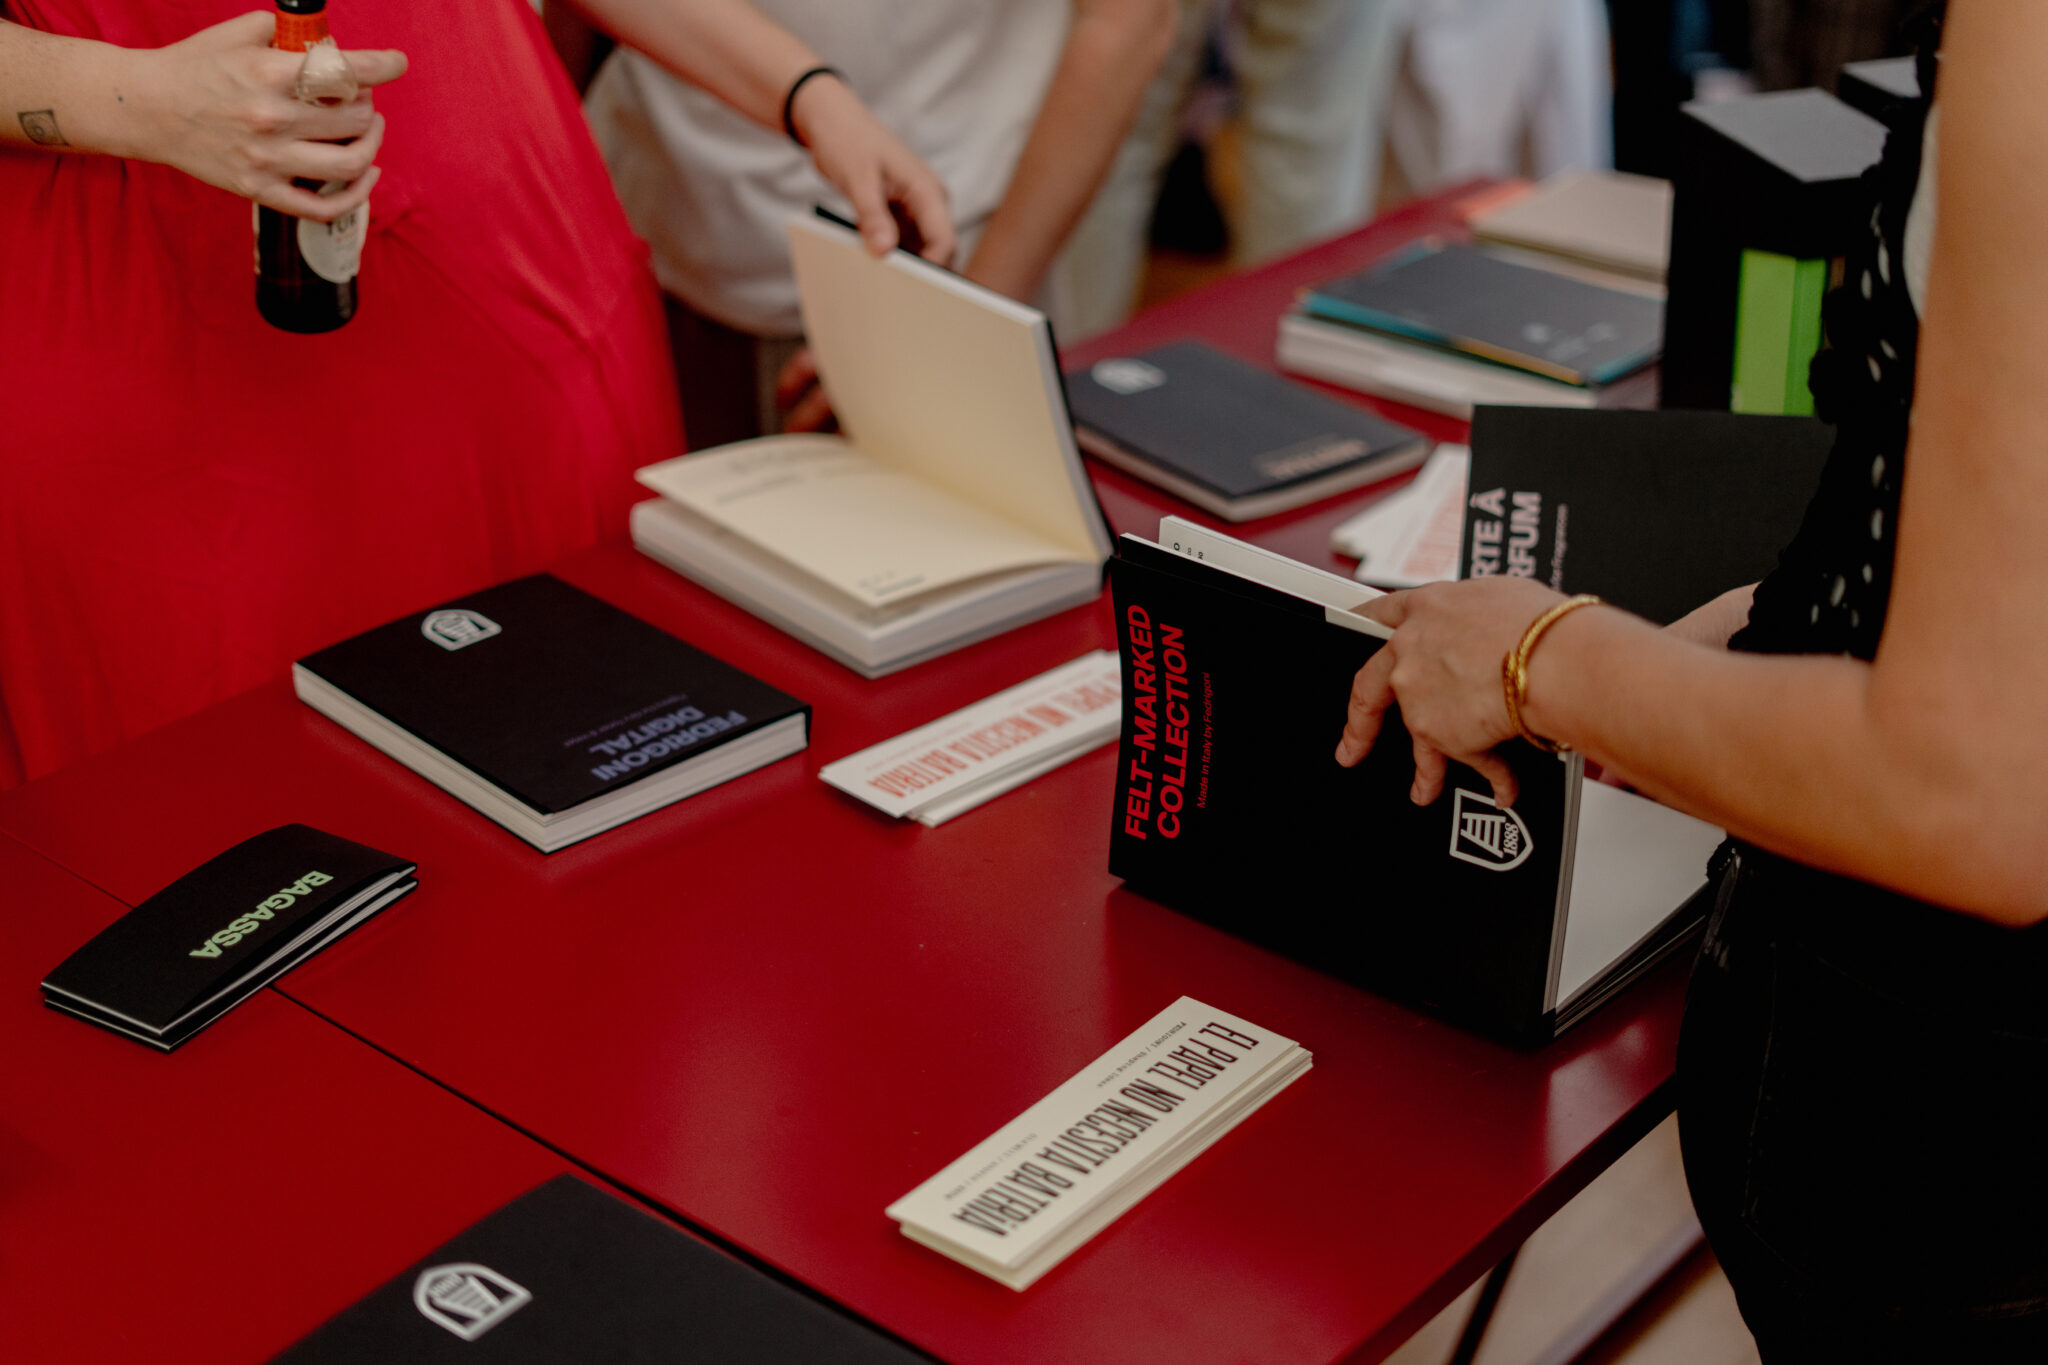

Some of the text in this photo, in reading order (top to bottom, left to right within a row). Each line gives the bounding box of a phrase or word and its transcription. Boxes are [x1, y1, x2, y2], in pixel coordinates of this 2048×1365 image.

[588, 705, 706, 755] DIGITAL
[591, 710, 748, 781] FEDRIGONI
[1125, 604, 1156, 840] FELT-MARKED
[1157, 623, 1190, 839] COLLECTION
[1197, 672, 1214, 809] Made in Italy by Fedrigoni
[1503, 822, 1520, 858] 1888
[188, 870, 335, 958] BAGASSA
[1146, 1038, 1240, 1090] PAPEL
[1198, 1021, 1260, 1051] EL
[1118, 1077, 1187, 1114] NO
[1035, 1097, 1160, 1175] NECESITA
